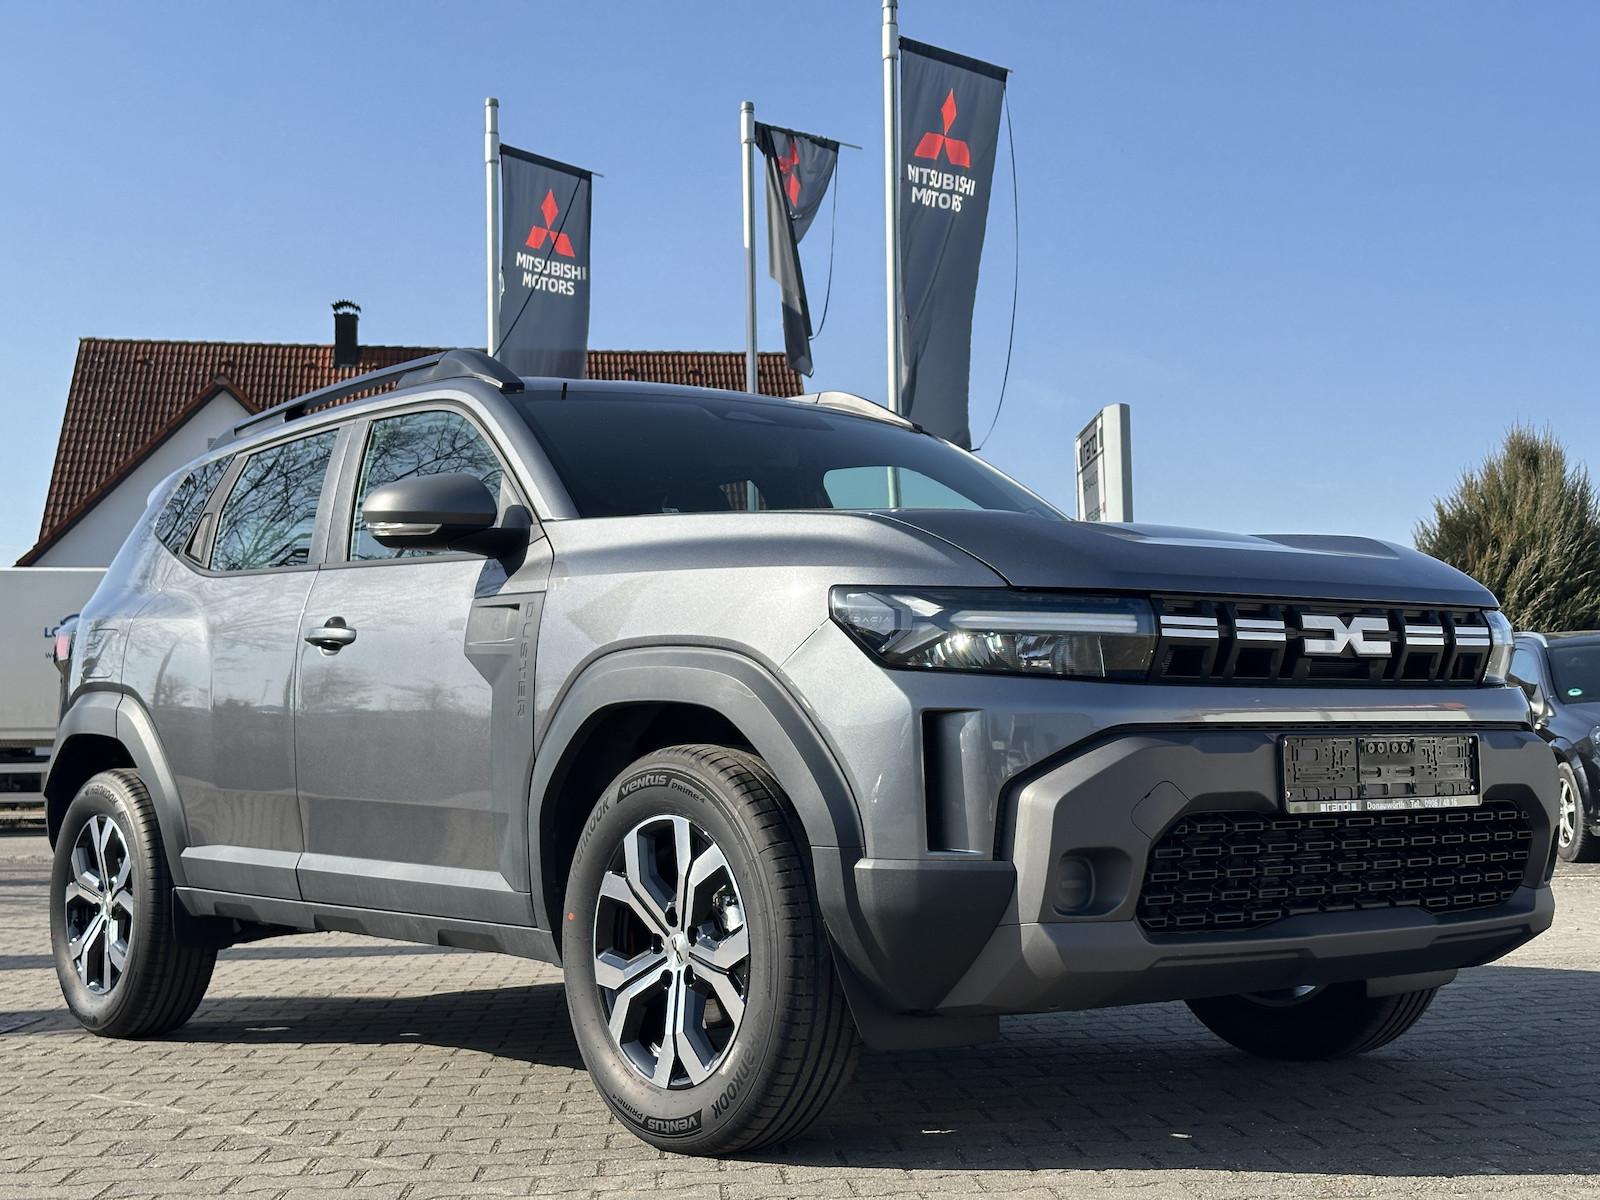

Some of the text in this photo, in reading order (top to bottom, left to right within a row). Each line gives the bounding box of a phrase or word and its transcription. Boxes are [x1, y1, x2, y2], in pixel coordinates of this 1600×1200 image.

[907, 163, 976, 196] MITSUBISHI
[911, 186, 963, 212] MOTORS
[516, 251, 586, 280] MITSUBISHI
[522, 271, 575, 296] MOTORS
[517, 601, 535, 717] DUSTER
